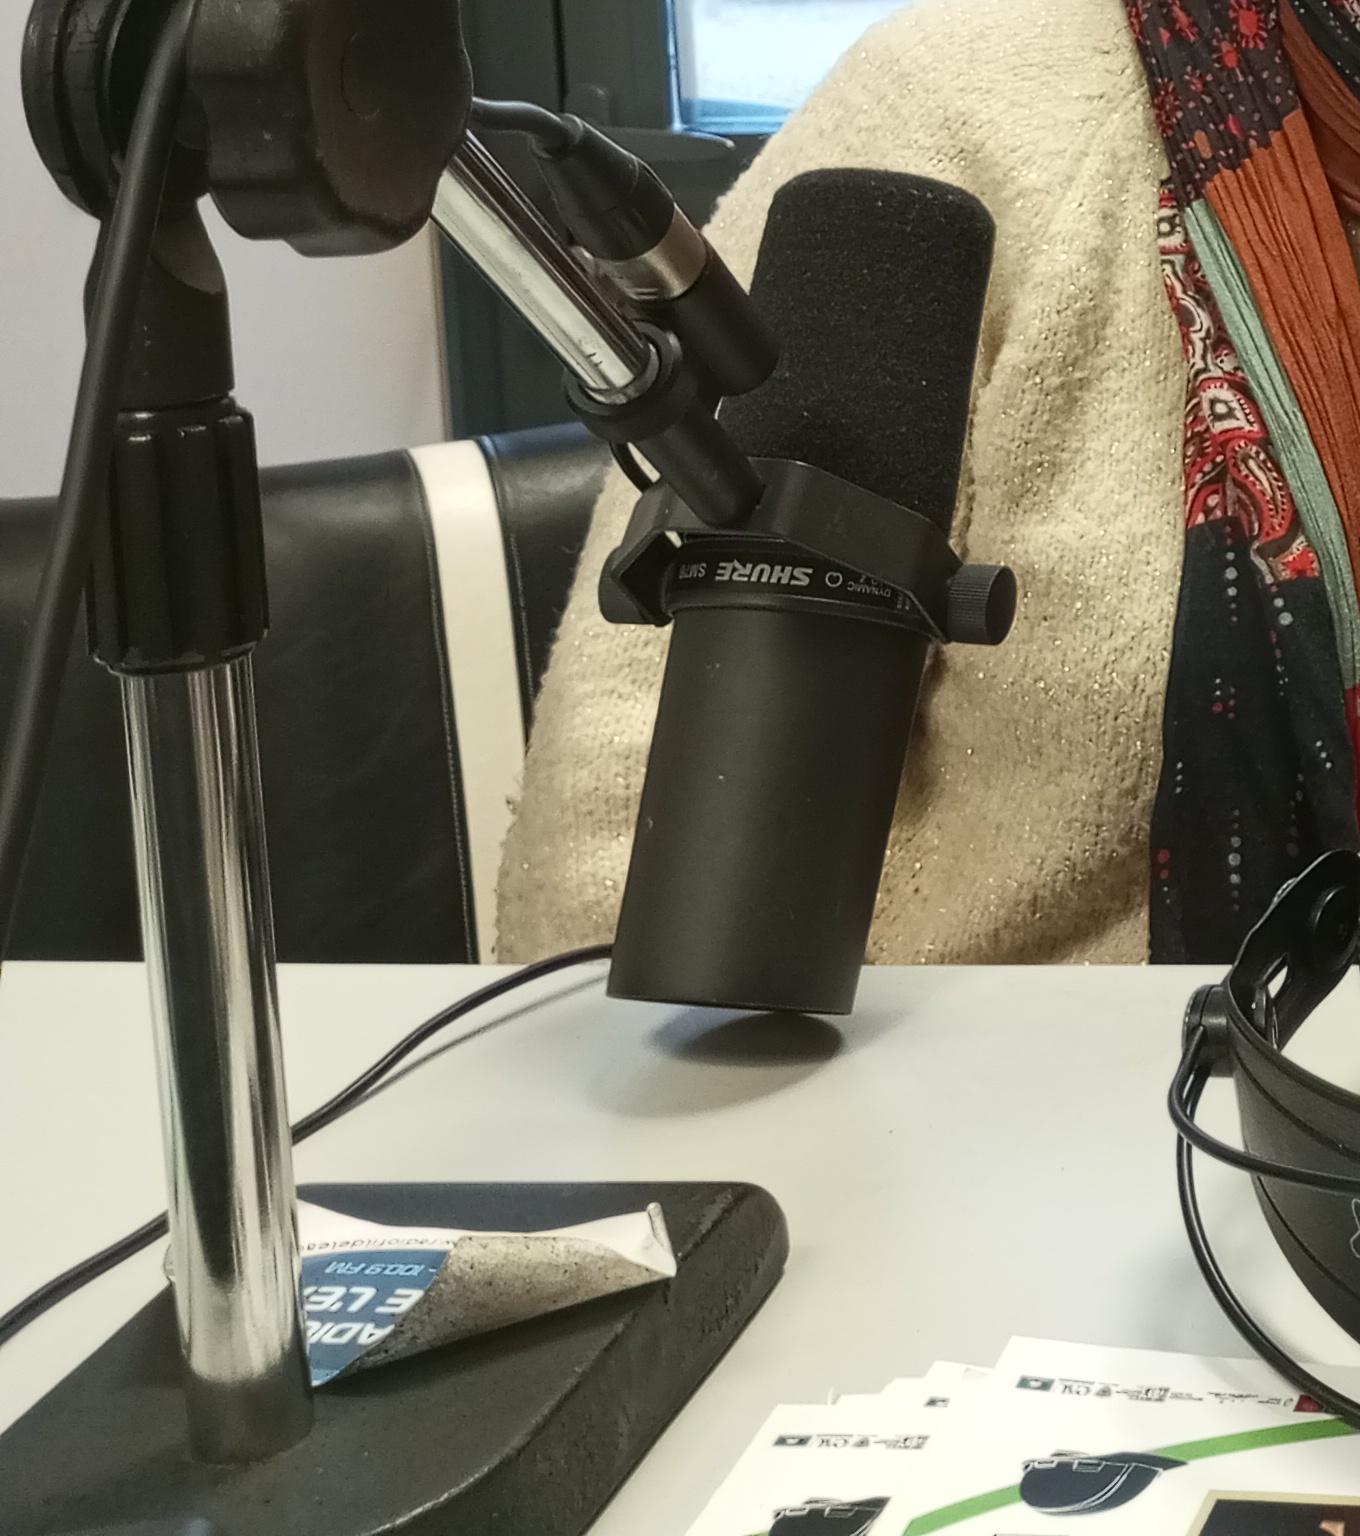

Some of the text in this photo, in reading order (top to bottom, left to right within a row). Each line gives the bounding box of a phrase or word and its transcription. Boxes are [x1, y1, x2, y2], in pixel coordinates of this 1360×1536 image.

[715, 558, 815, 587] SHURE
[846, 580, 892, 599] DYNAMIC
[324, 1261, 365, 1276] FM
[374, 1287, 426, 1315] E
